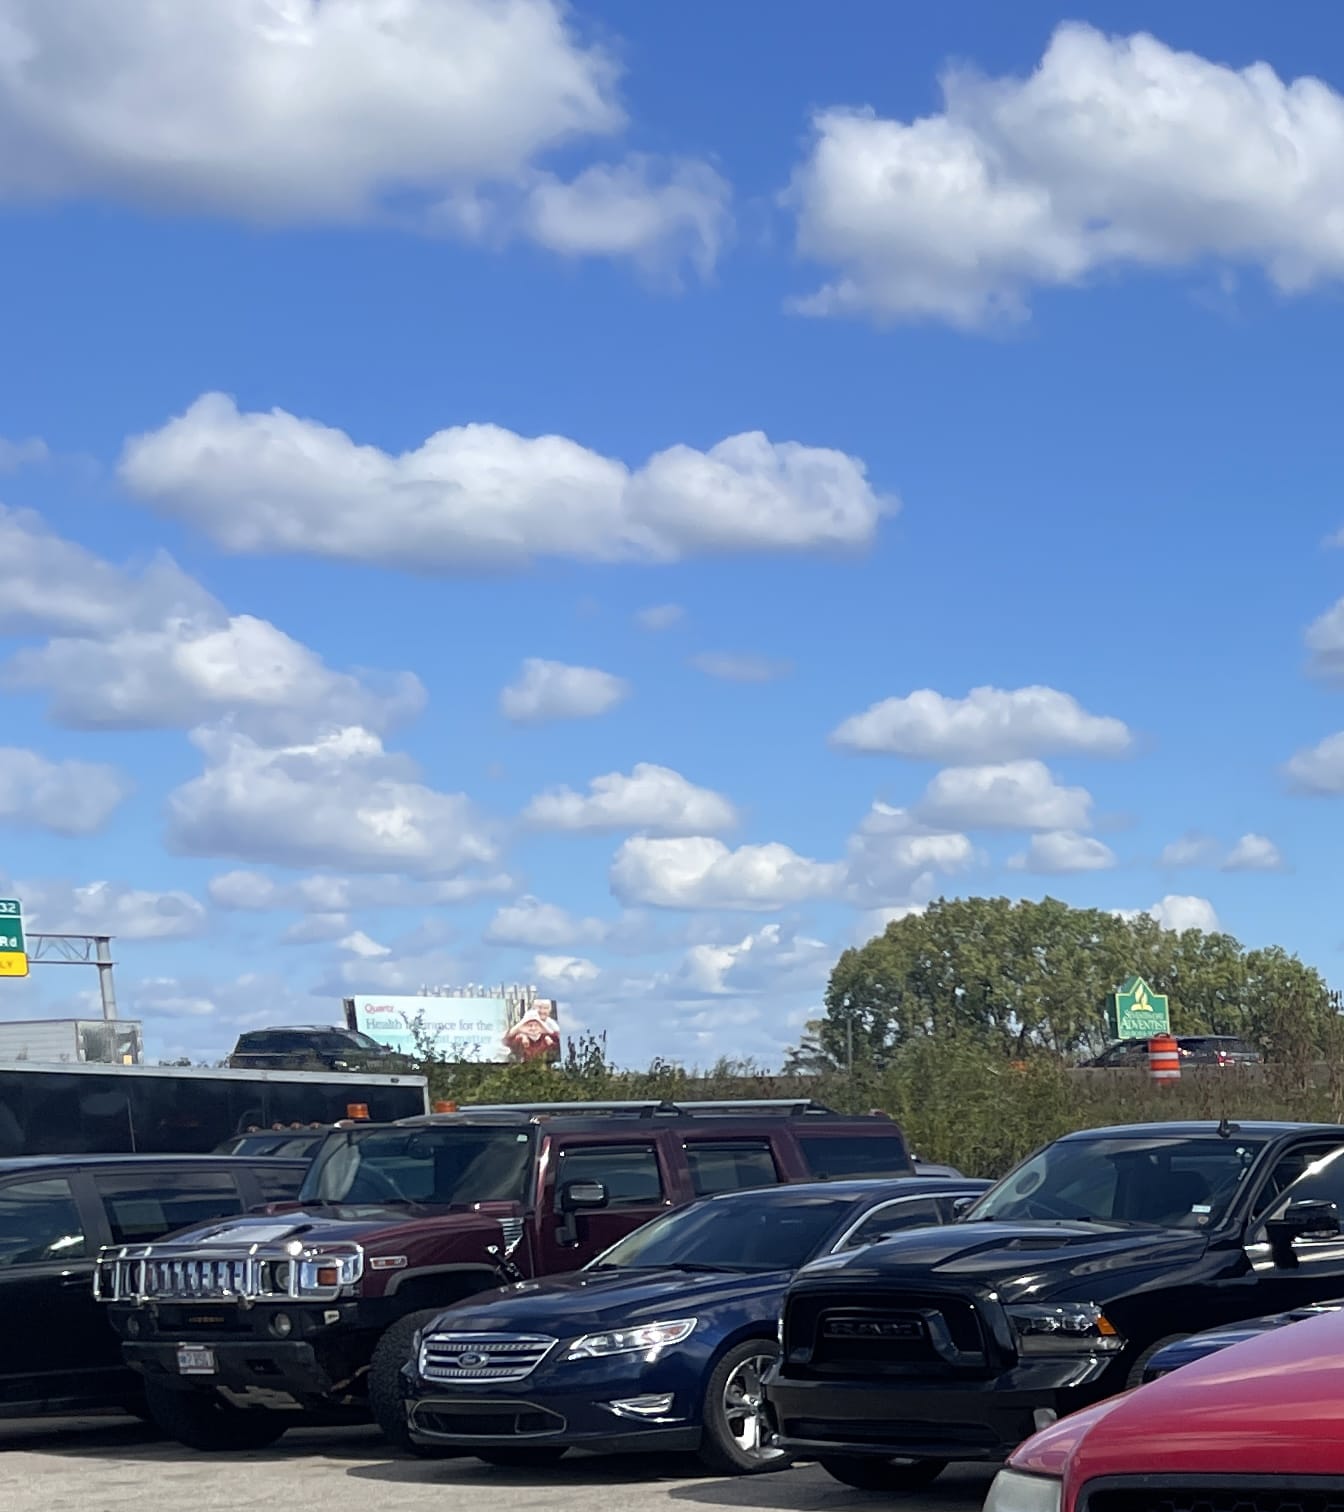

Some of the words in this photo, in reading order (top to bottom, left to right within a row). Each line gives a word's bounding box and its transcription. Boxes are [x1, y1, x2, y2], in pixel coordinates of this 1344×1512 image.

[364, 1003, 394, 1014] Quartz
[366, 1019, 402, 1030] Health
[459, 1019, 474, 1030] for
[477, 1020, 493, 1030] the
